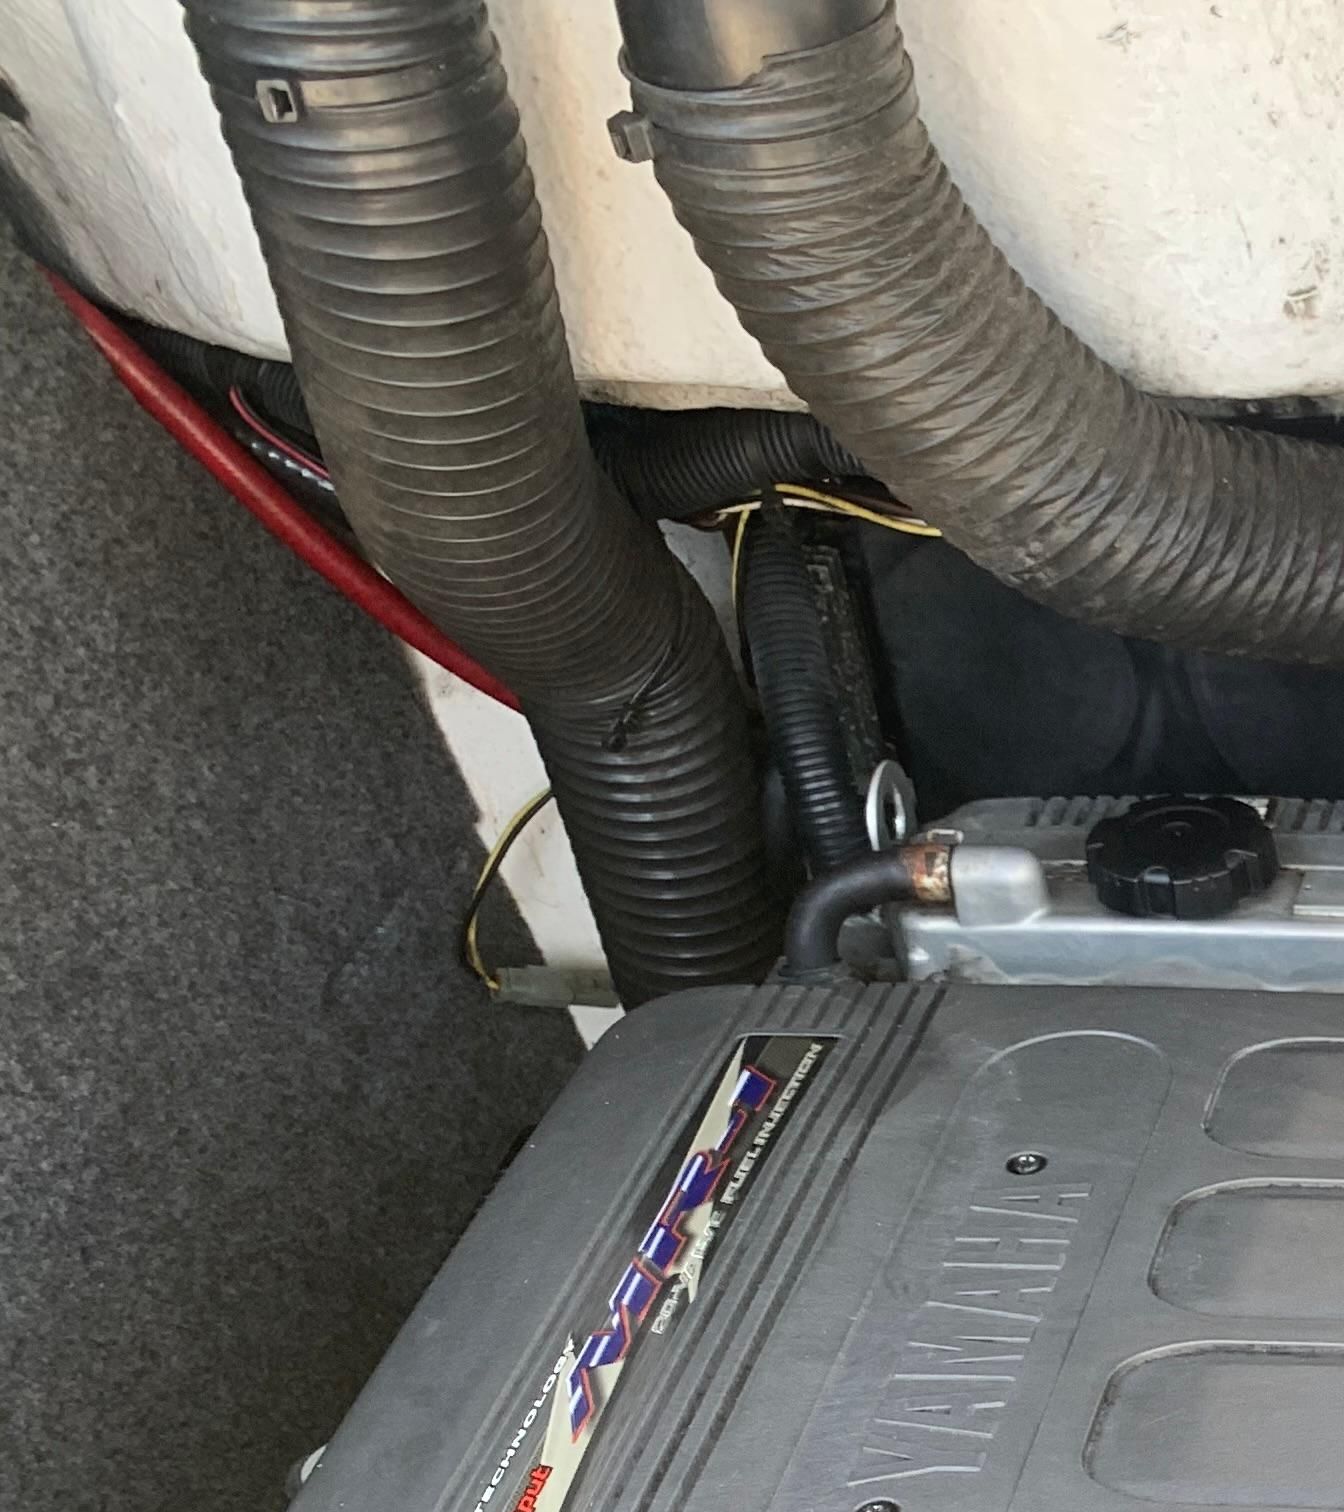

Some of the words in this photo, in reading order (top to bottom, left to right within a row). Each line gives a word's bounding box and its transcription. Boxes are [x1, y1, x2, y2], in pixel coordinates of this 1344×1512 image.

[566, 1064, 777, 1444] MR-1
[720, 1146, 761, 1205] FUEL
[753, 1042, 824, 1147] INJECTION
[847, 1182, 1094, 1488] YAMAHA
